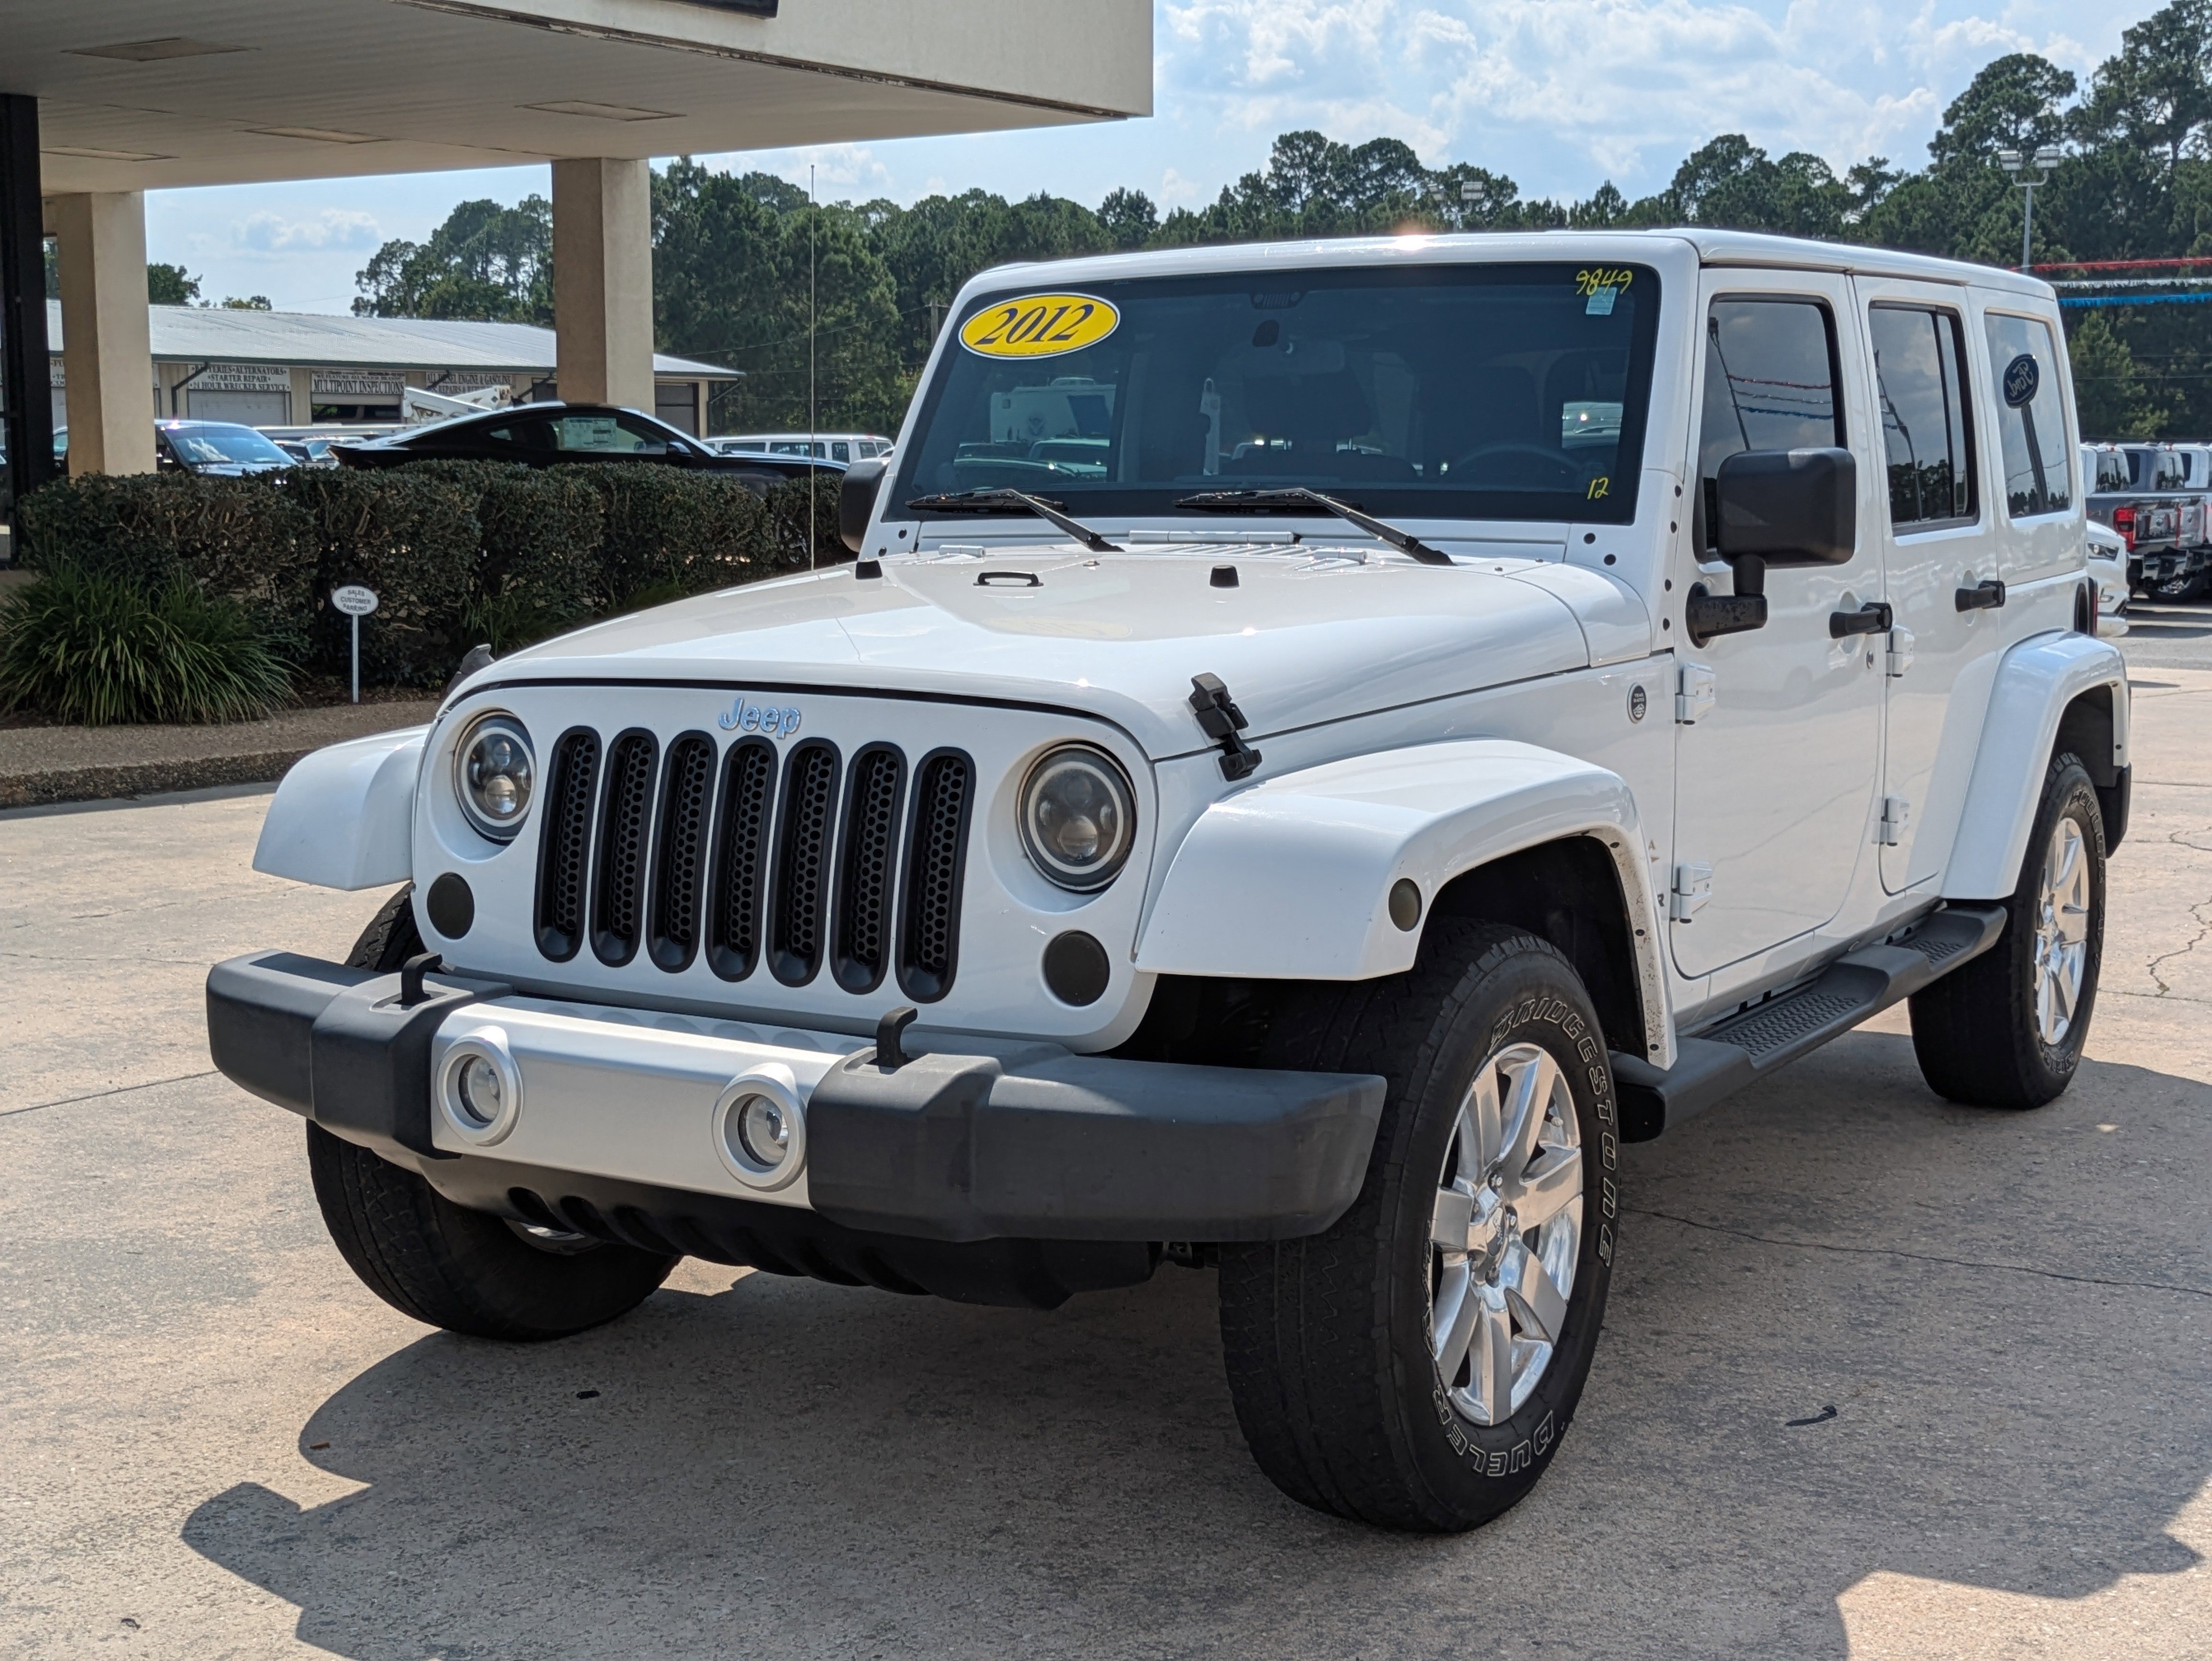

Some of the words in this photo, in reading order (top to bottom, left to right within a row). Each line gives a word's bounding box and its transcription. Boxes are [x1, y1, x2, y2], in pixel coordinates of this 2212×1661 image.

[1576, 268, 1633, 295] 9849
[973, 304, 1095, 345] 2012
[314, 379, 357, 393] MULTIPOINT
[359, 381, 404, 394] INSPECTIONS
[1587, 477, 1608, 499] 12
[341, 597, 371, 605] CUSTOMER
[343, 603, 367, 611] PARKING
[719, 698, 801, 740] Jeep
[1487, 997, 1616, 1267] BRIDGESTONE
[1432, 1384, 1554, 1476] DUELER
